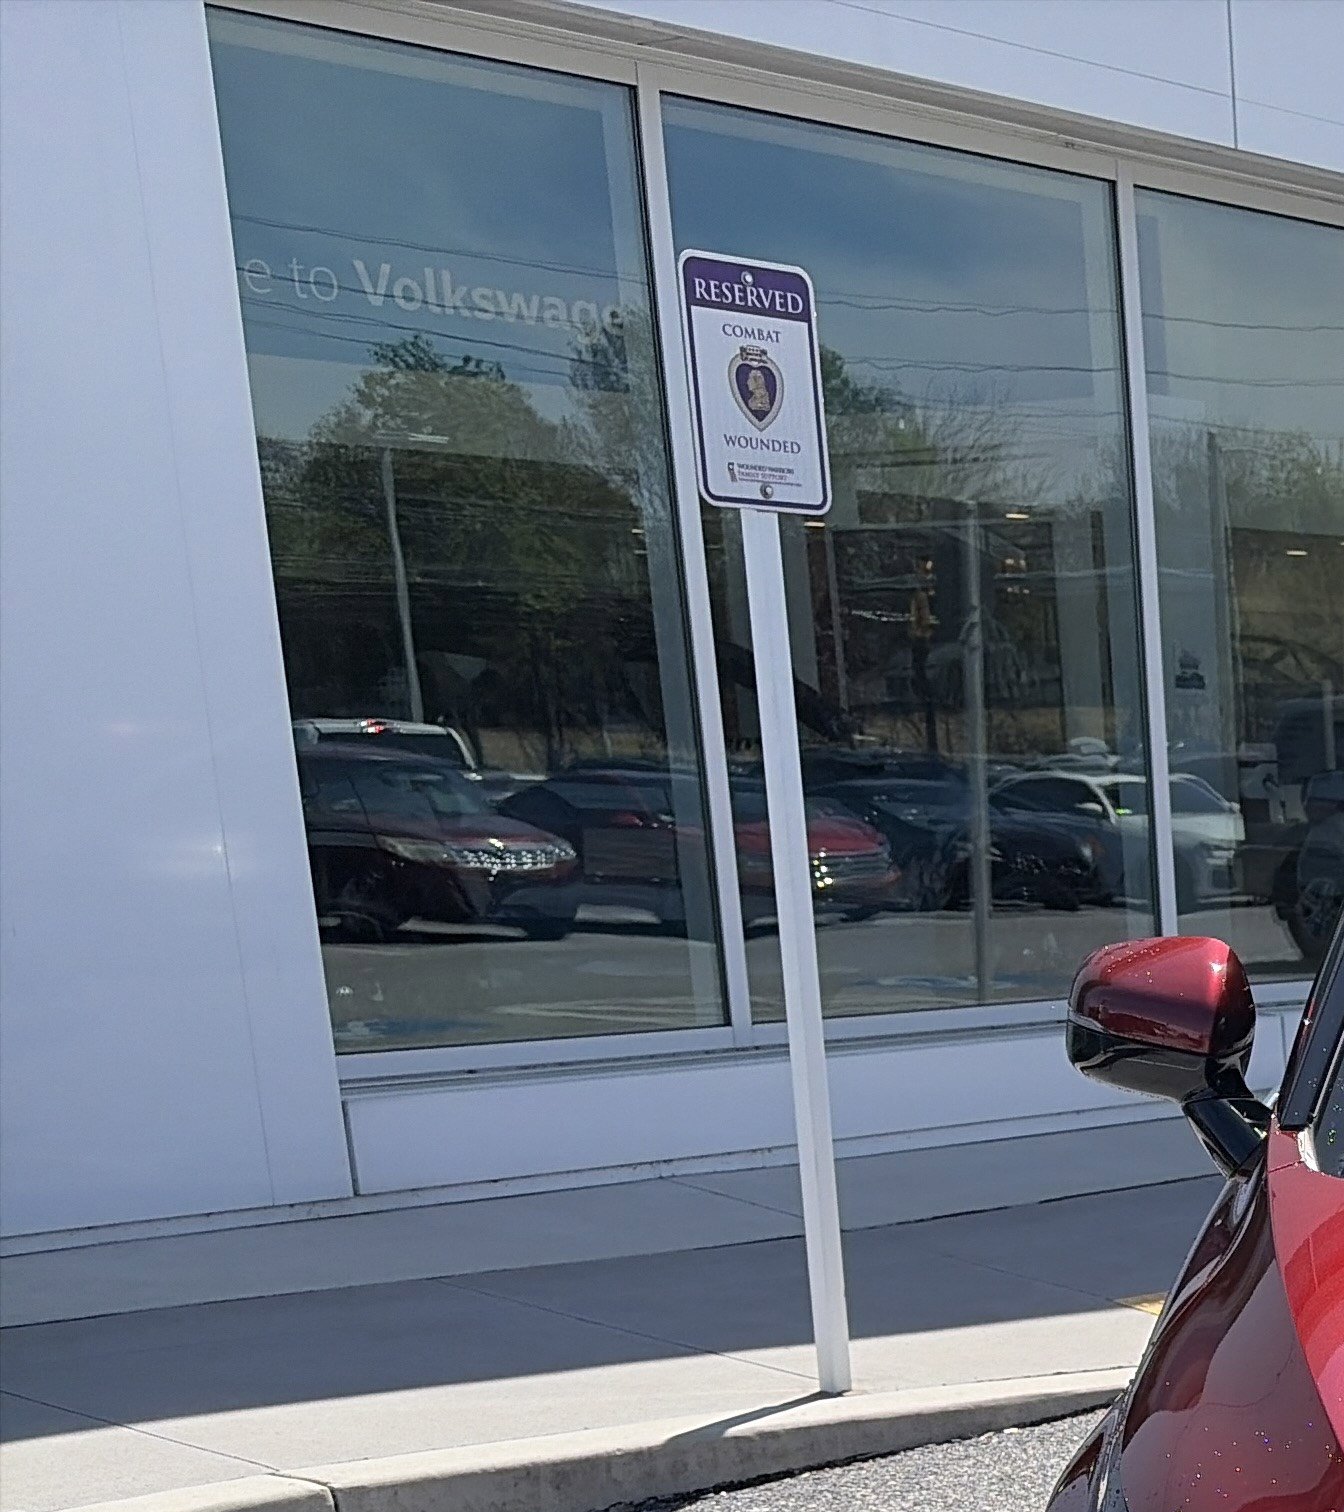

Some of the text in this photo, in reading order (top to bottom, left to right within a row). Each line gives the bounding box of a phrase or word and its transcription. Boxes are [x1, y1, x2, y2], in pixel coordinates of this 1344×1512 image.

[288, 257, 340, 302] to
[352, 258, 626, 343] Volkswage
[693, 277, 804, 315] RESERVED
[721, 323, 782, 343] COMBAT
[723, 433, 801, 455] WOUNDED
